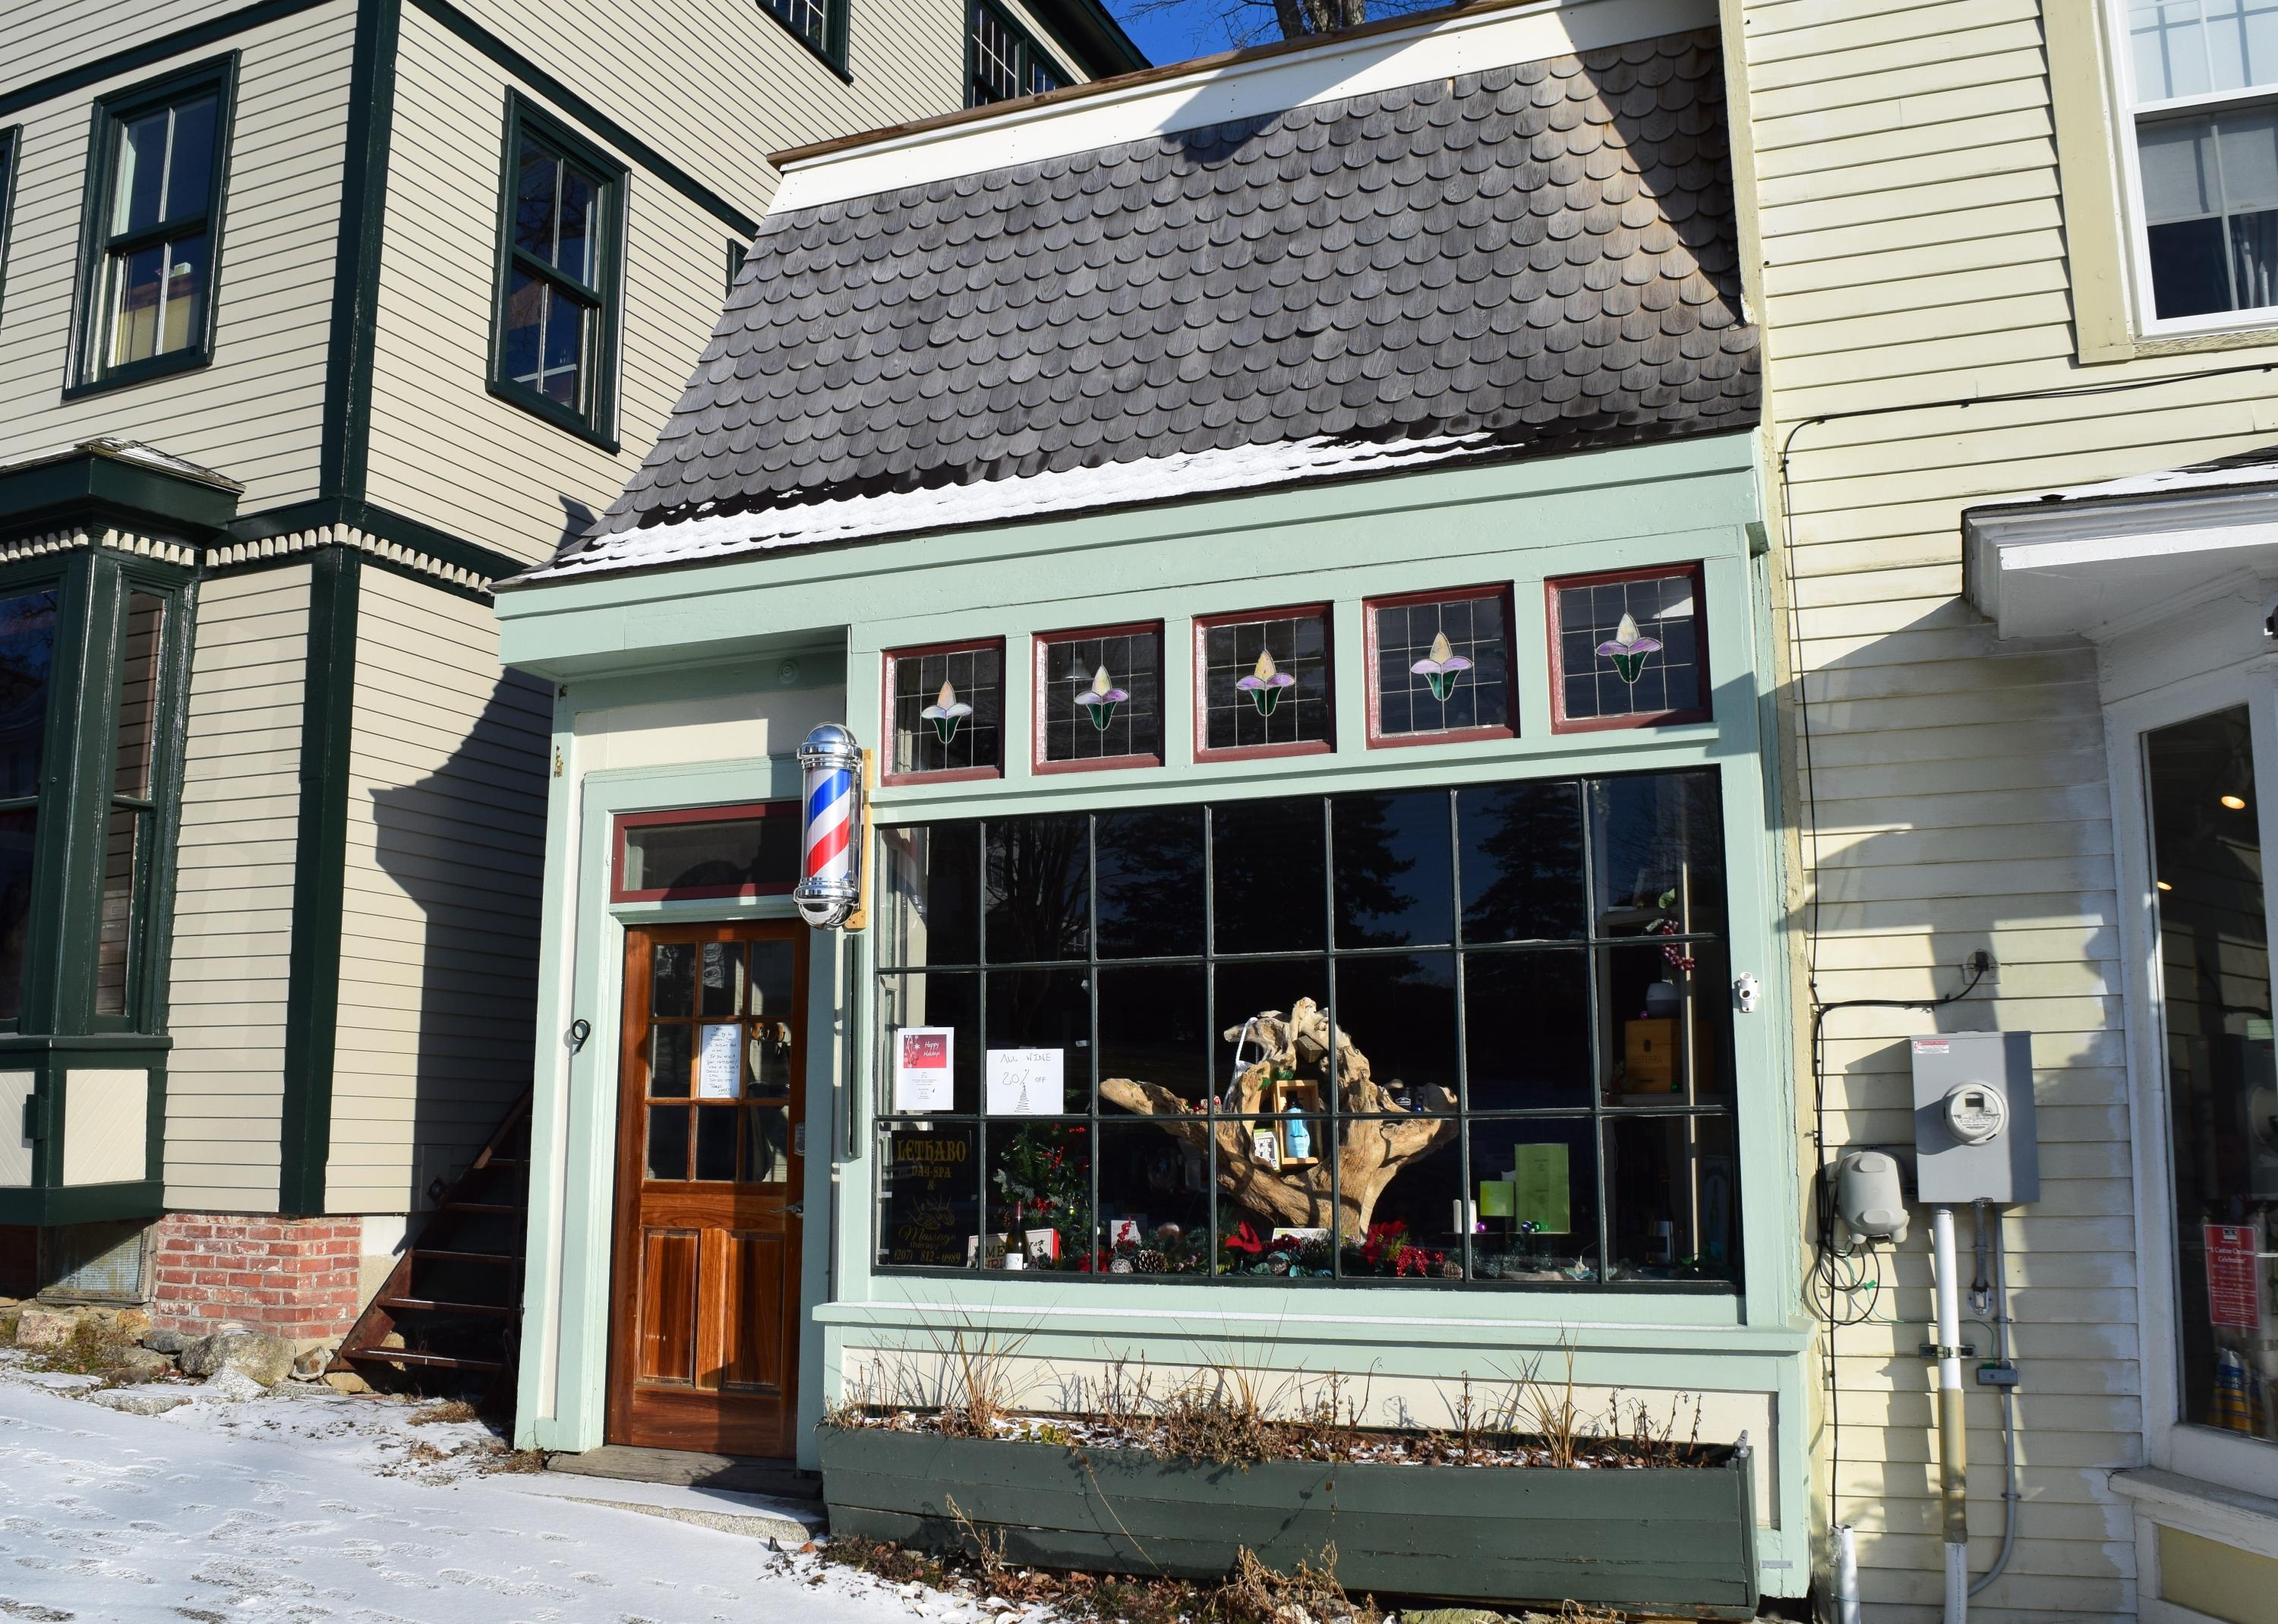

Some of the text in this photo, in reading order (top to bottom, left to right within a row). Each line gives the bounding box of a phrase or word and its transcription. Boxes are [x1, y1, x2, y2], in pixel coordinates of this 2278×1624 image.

[572, 1019, 591, 1053] 9
[925, 1041, 939, 1050] Happy
[1000, 1052, 1051, 1063] ALL WINE
[1002, 1069, 1030, 1086] 20%
[927, 1180, 936, 1190] &
[898, 1225, 956, 1245] Massage
[894, 1249, 913, 1260] (207)
